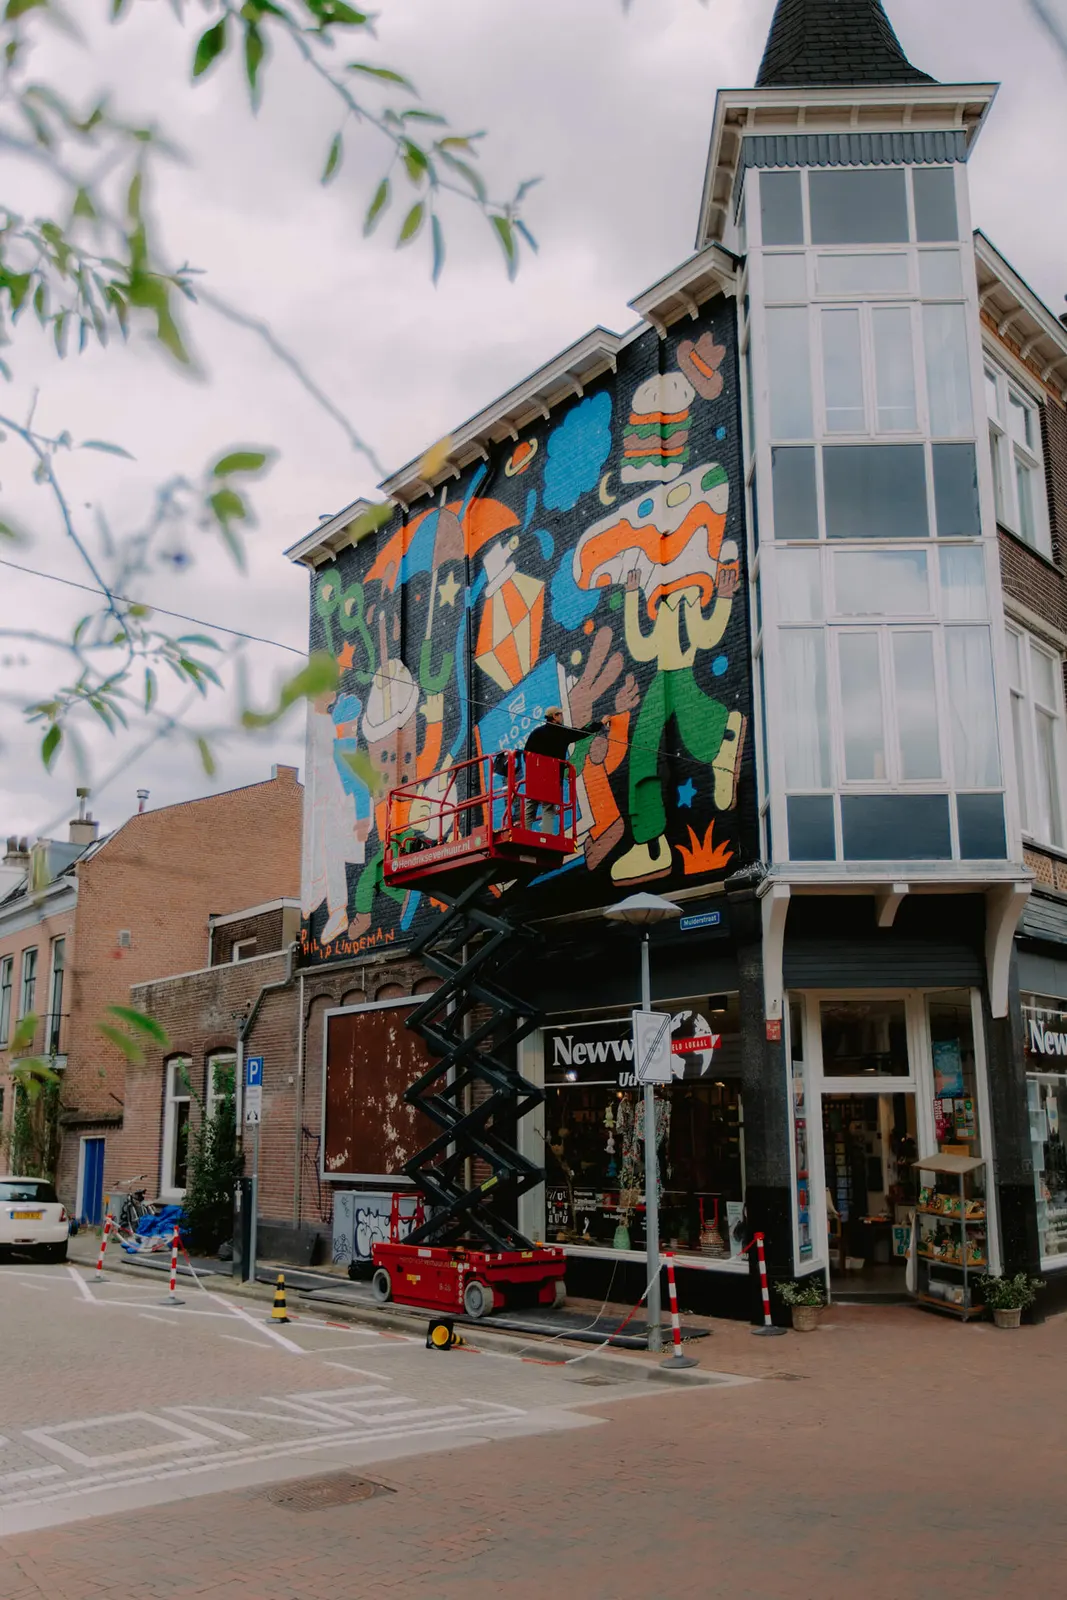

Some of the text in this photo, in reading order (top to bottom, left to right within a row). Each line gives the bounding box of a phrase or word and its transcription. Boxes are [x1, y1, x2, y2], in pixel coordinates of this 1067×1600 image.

[398, 839, 470, 869] Hendrikseverhuur.nl
[335, 927, 395, 955] LINDEMAN
[685, 1039, 708, 1050] LOKAAL
[250, 1061, 259, 1083] P
